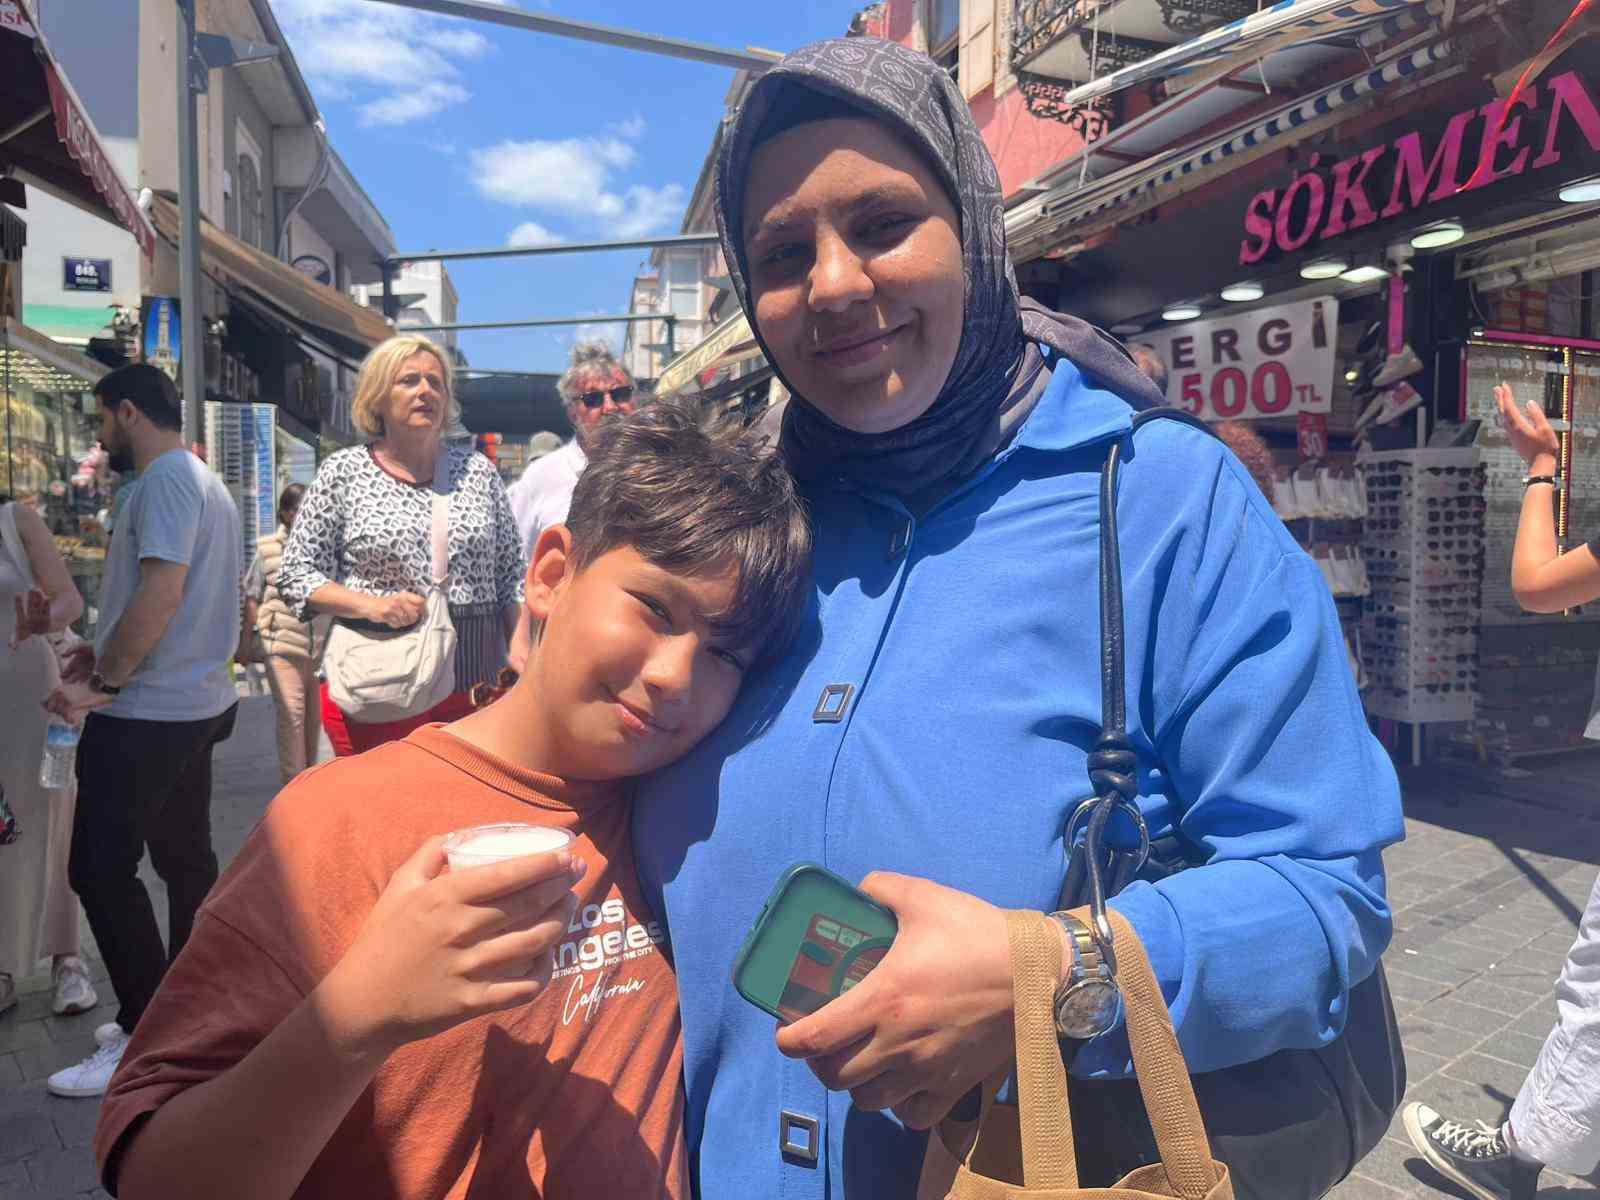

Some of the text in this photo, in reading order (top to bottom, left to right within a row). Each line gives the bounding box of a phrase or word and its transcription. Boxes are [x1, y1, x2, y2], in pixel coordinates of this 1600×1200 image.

[1145, 302, 1328, 369] ERGİ
[1181, 361, 1323, 417] 500 TL
[552, 920, 665, 971] ngeles
